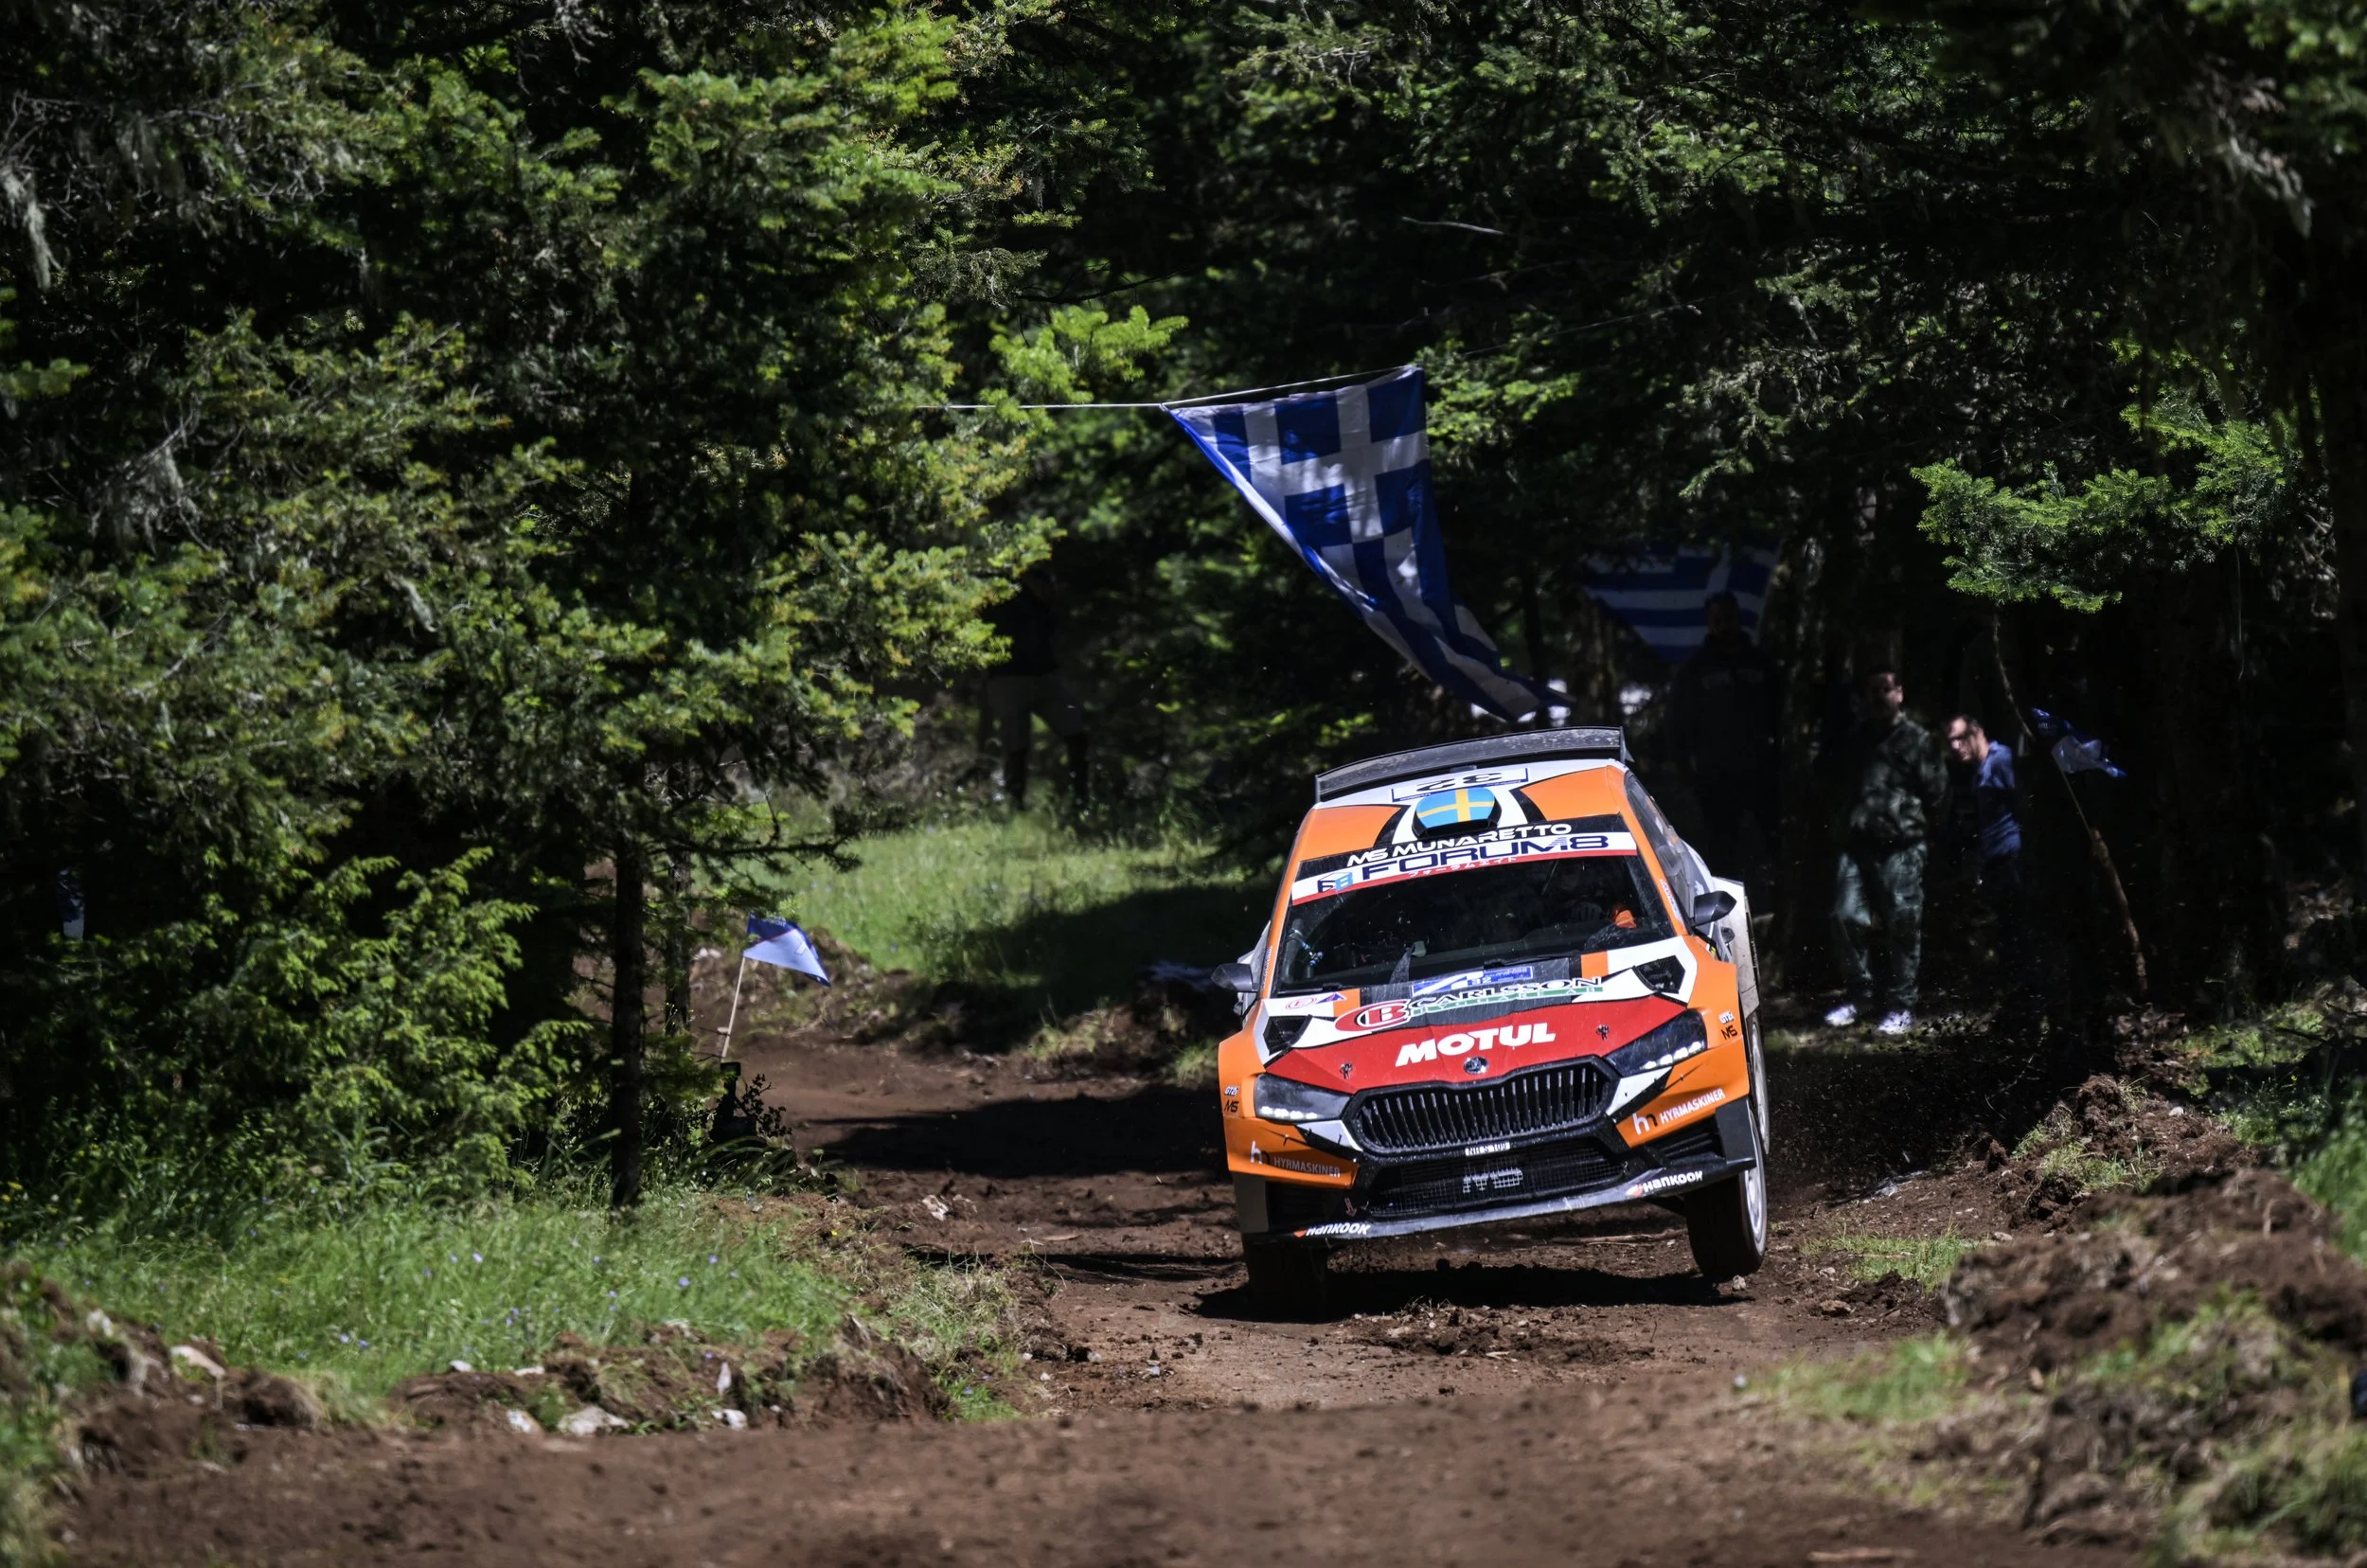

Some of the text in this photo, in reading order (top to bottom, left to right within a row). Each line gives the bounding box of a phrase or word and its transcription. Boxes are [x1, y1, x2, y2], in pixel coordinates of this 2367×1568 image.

[1346, 823, 1573, 867] MS MUNARETTO
[1361, 835, 1610, 881] FORUM8
[1408, 975, 1603, 1007] CARLSSON
[1395, 1022, 1557, 1067] MOTUL
[1659, 1088, 1726, 1124] HYRMASKINER
[1273, 1156, 1341, 1178] HYRMASKINER
